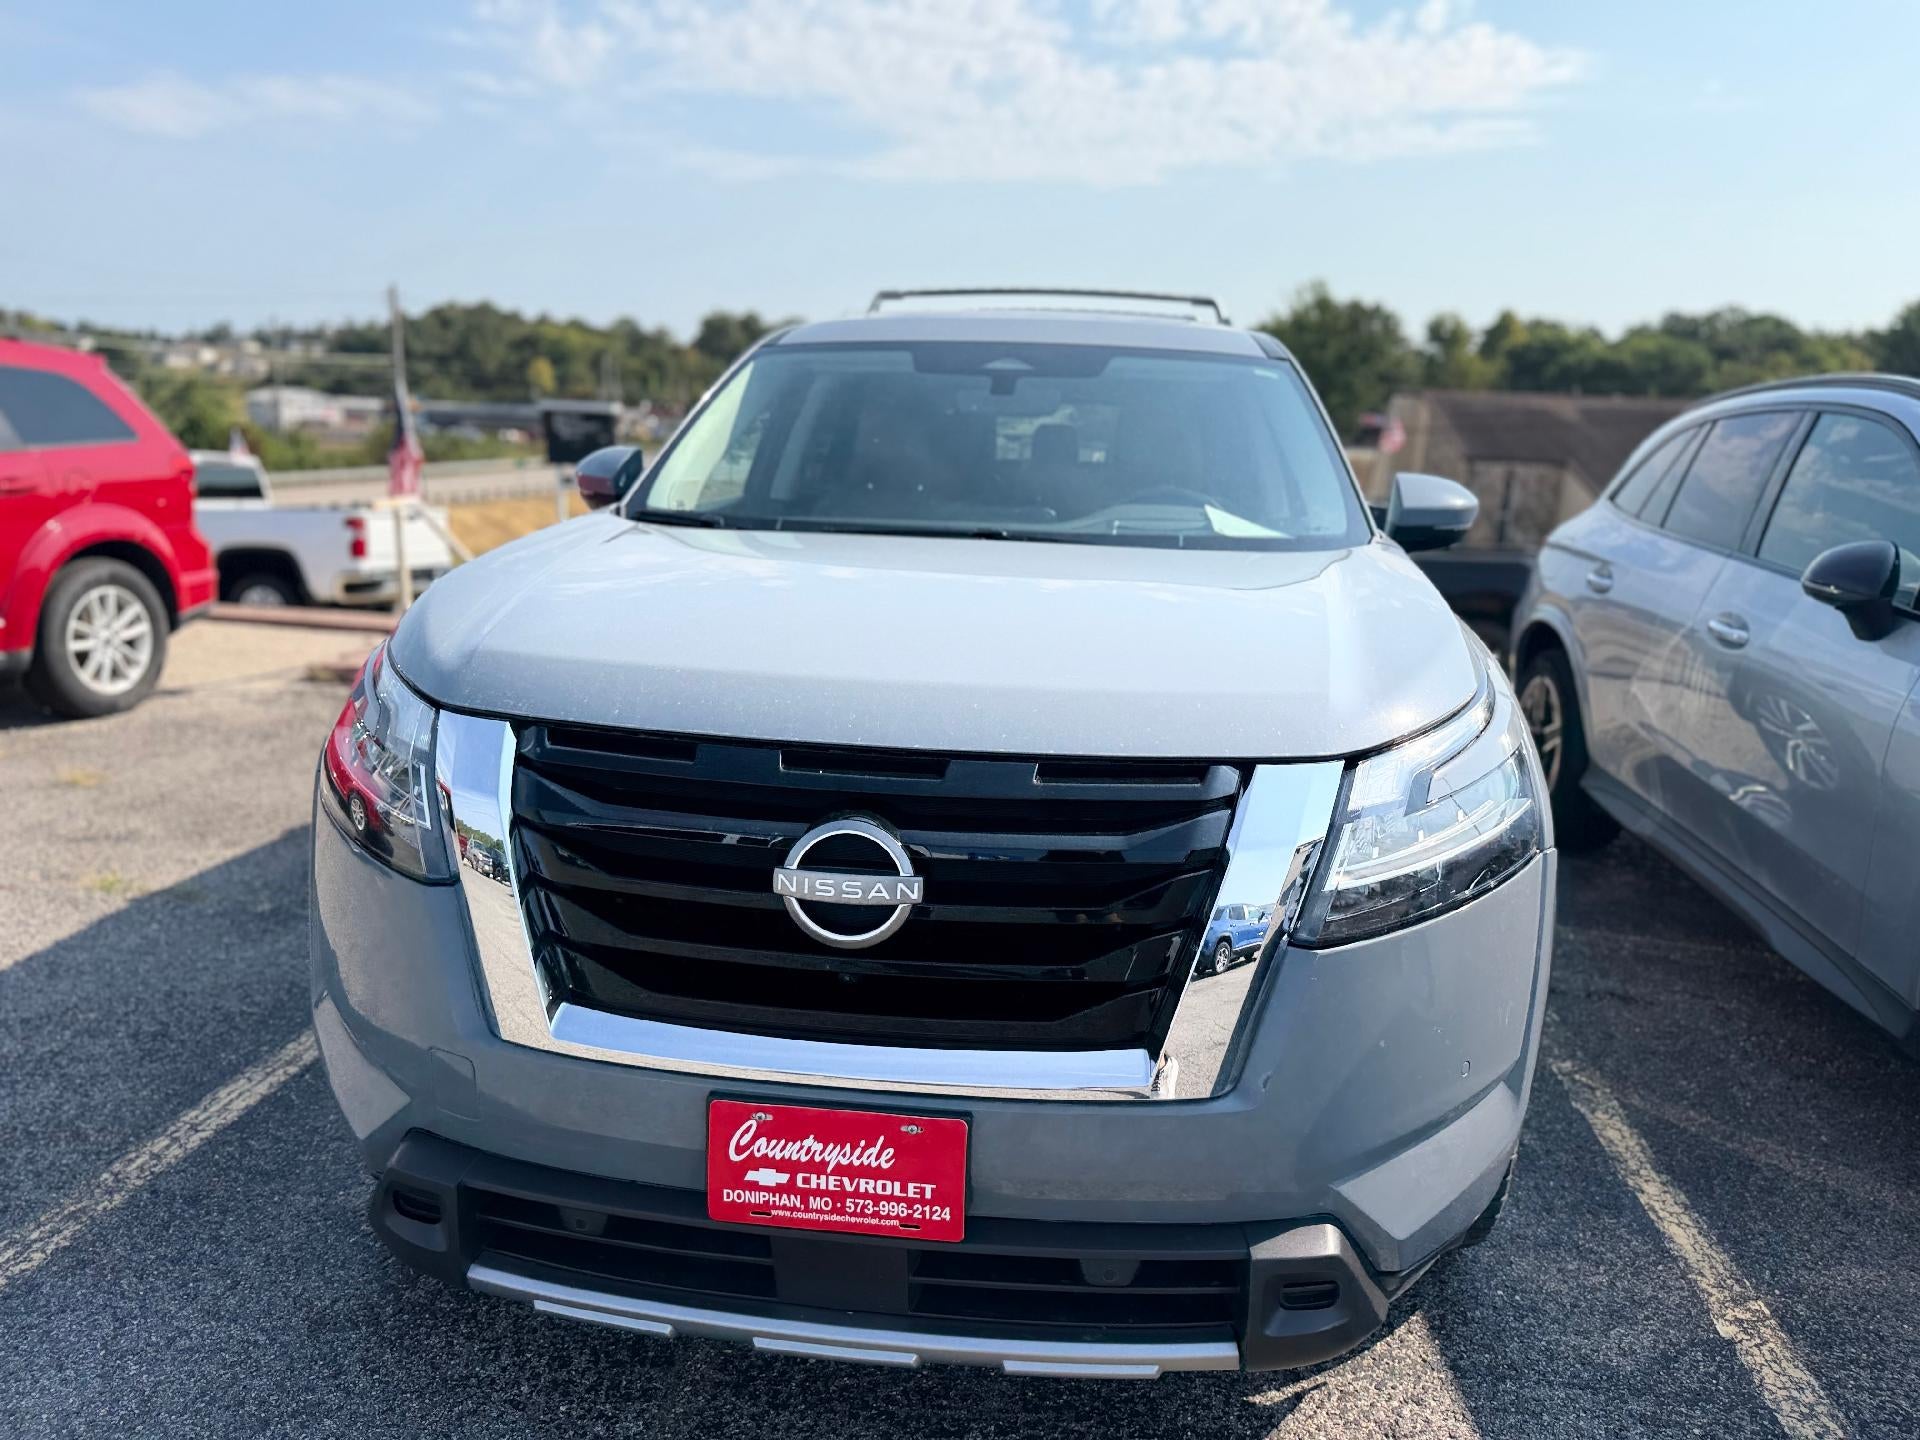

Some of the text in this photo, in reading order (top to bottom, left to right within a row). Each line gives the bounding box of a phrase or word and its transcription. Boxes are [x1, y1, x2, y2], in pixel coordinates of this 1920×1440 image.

[777, 873, 919, 900] NISSAN
[728, 1119, 895, 1173] Countryside
[796, 1172, 937, 1199] CHEVROLET
[723, 1188, 951, 1221] DONIPHAN, MO 573-996-2124
[771, 1208, 900, 1227] www.countrysidechevrolet.com
